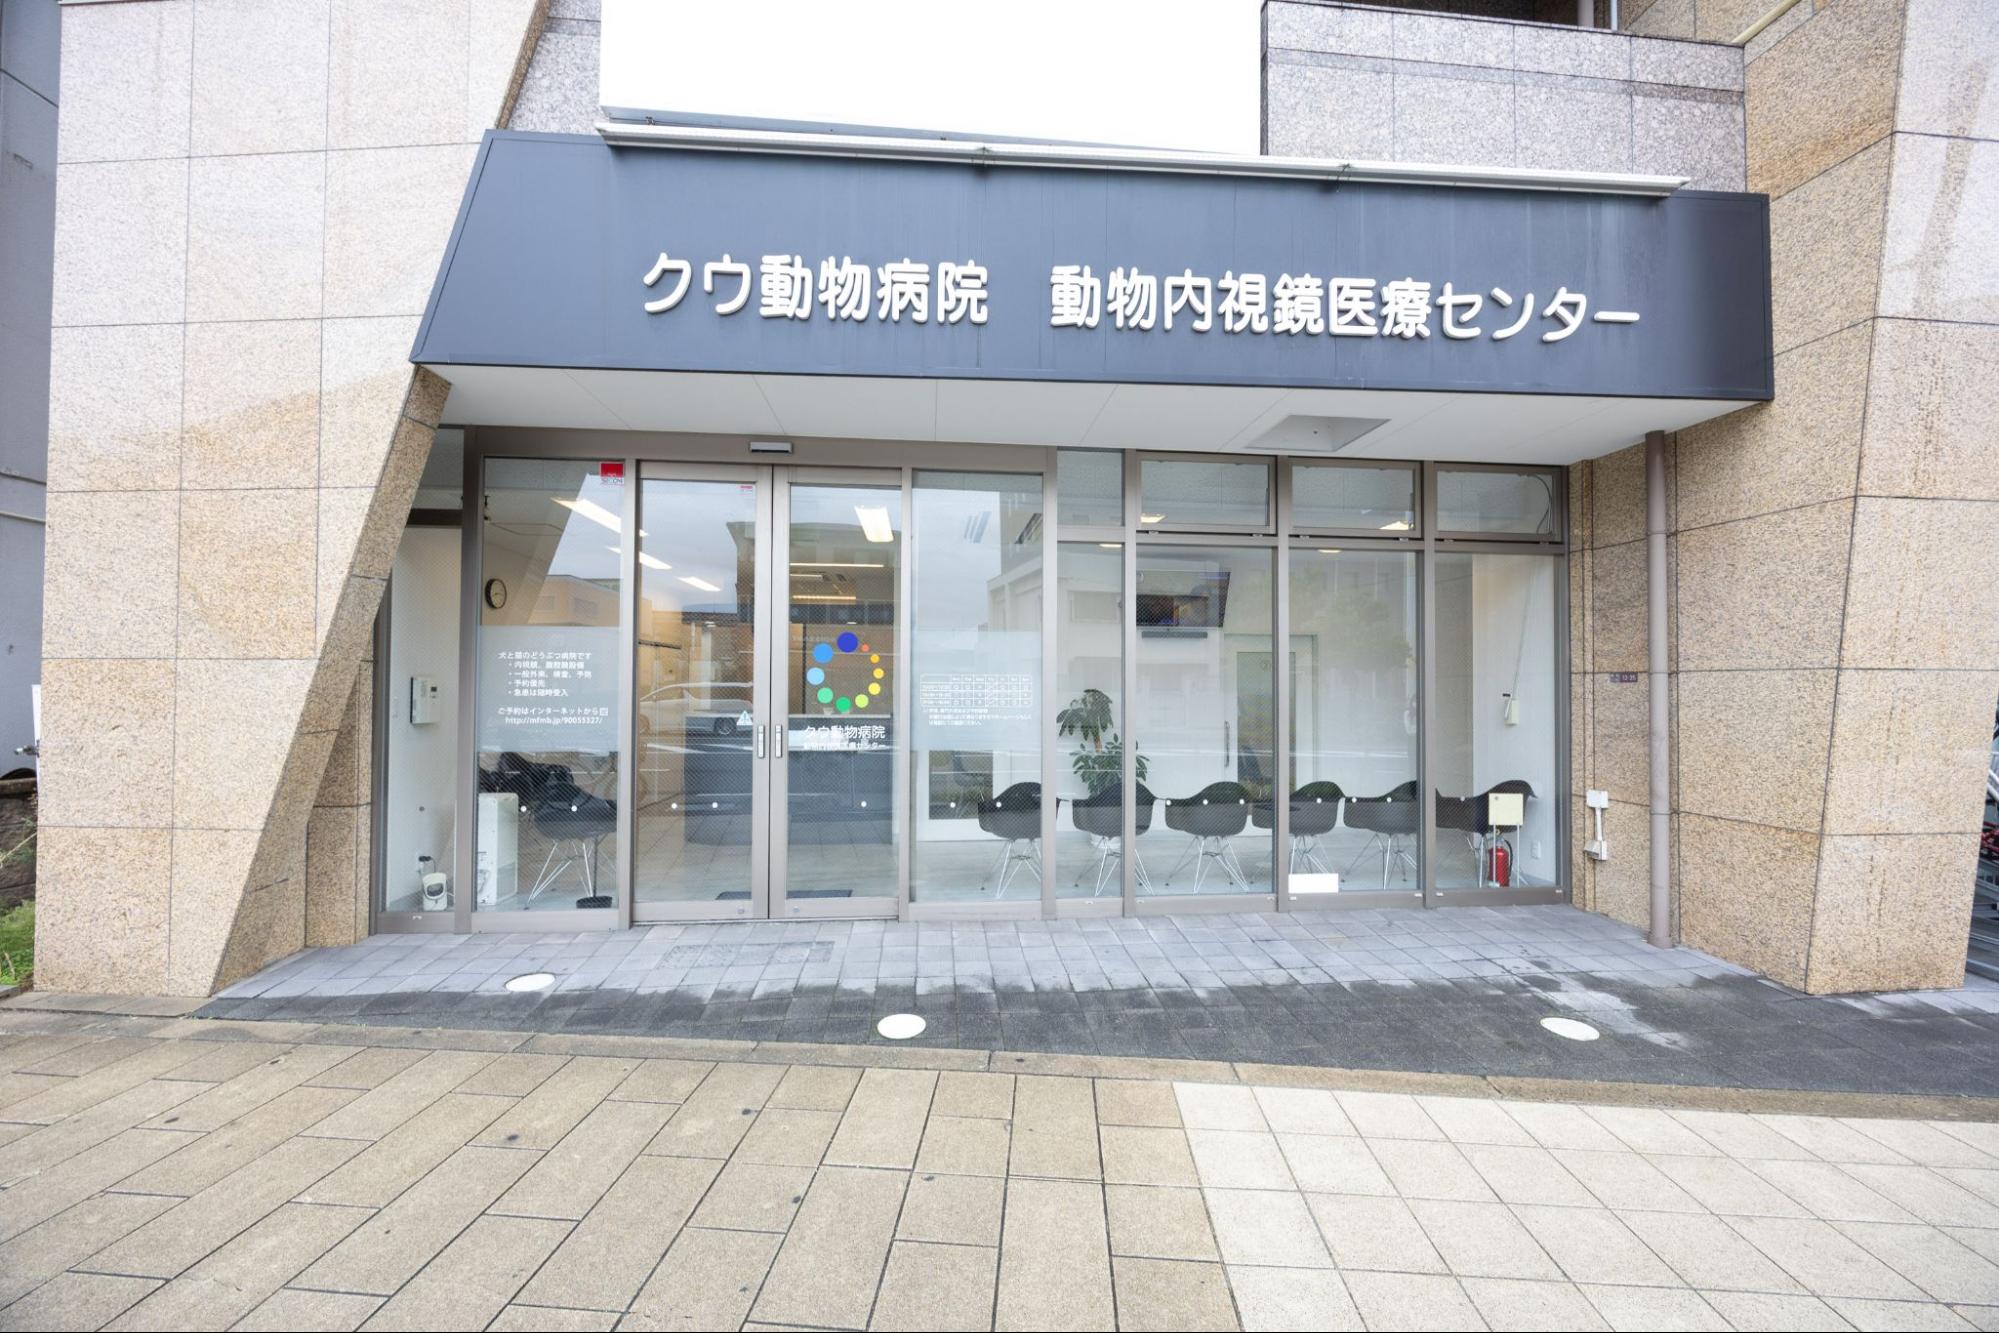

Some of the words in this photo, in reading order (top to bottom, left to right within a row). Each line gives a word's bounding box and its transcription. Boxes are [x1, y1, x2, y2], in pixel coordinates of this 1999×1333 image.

[643, 252, 988, 324] クウ動物病院
[1049, 265, 1641, 344] 動物内視鏡医療センター
[498, 651, 592, 660] 犬と猫のどうぶつ病院です
[804, 725, 886, 739] クウ動物病院
